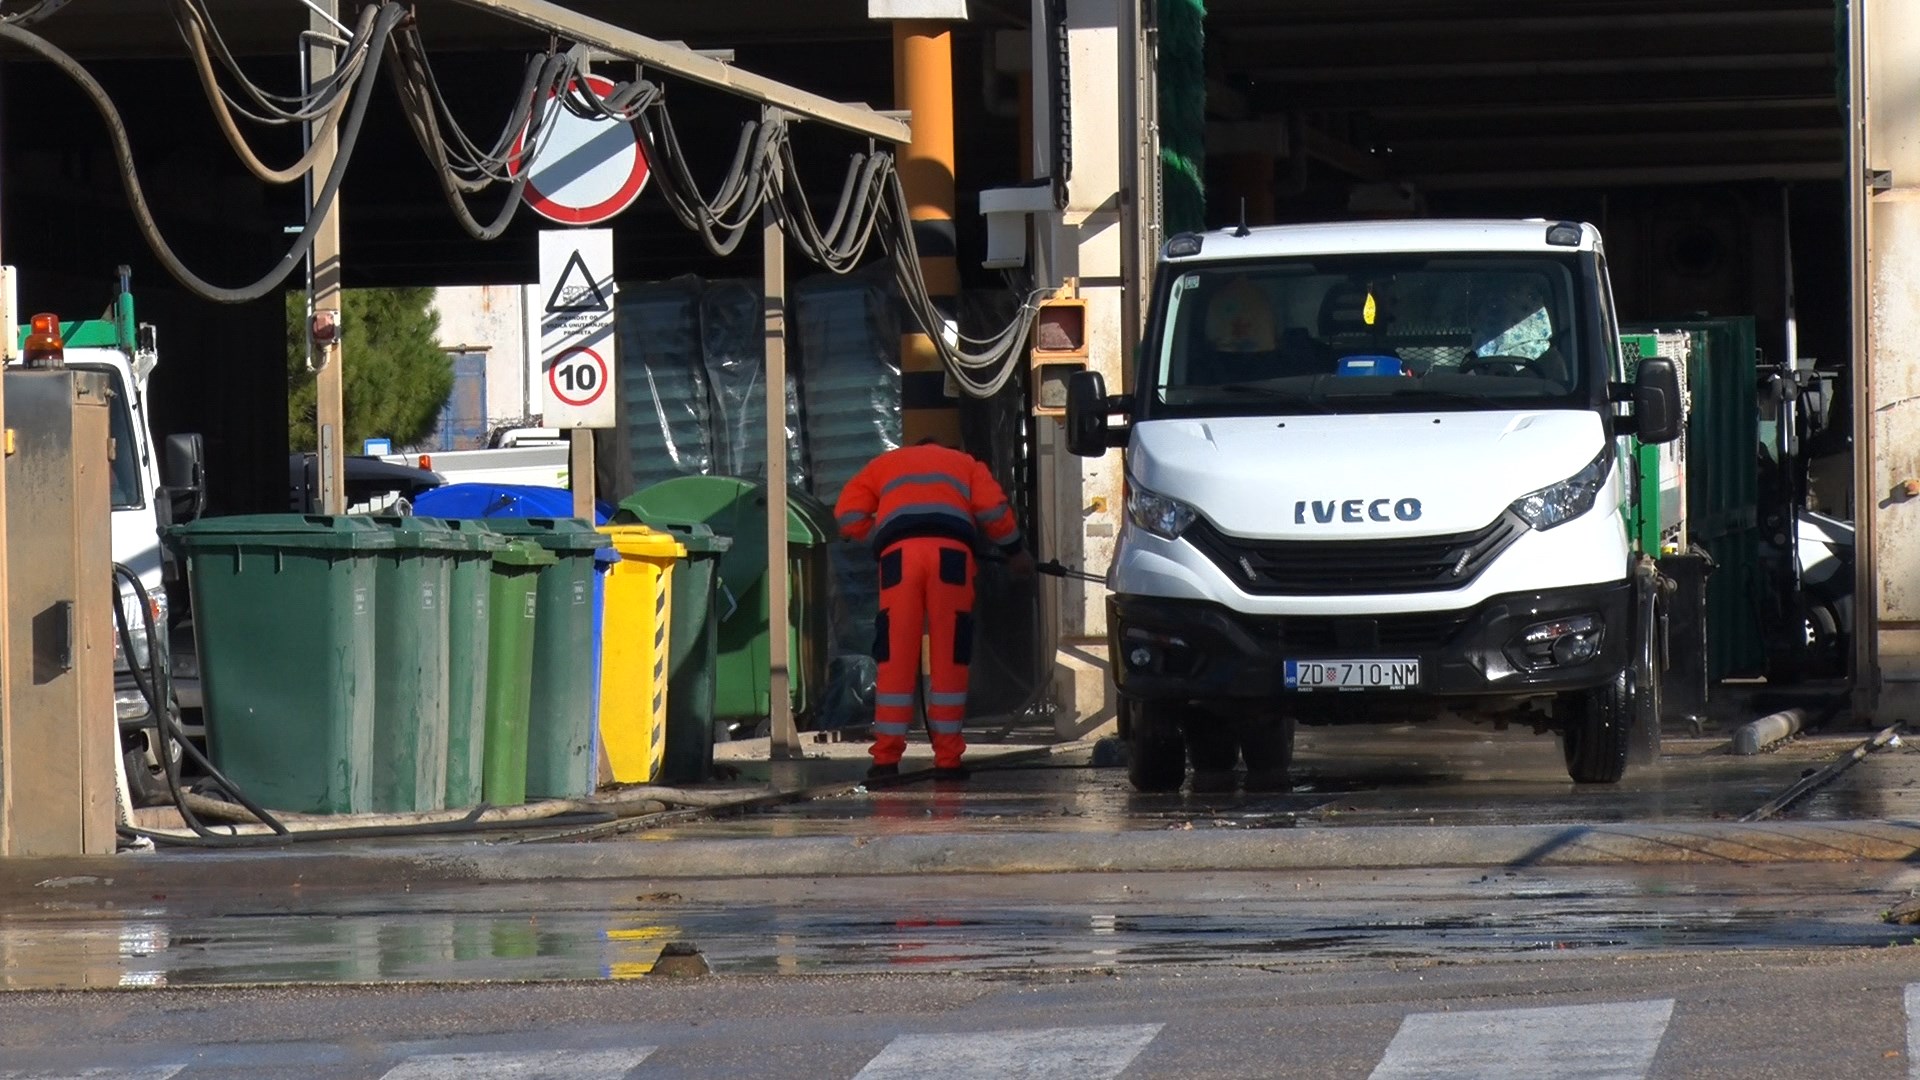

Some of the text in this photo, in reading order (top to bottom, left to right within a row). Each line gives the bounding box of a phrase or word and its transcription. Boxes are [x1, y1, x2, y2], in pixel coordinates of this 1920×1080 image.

[559, 364, 596, 391] 10
[1294, 498, 1422, 524] IVECO
[1299, 664, 1324, 684] ZD
[1341, 664, 1418, 685] 710-NM
